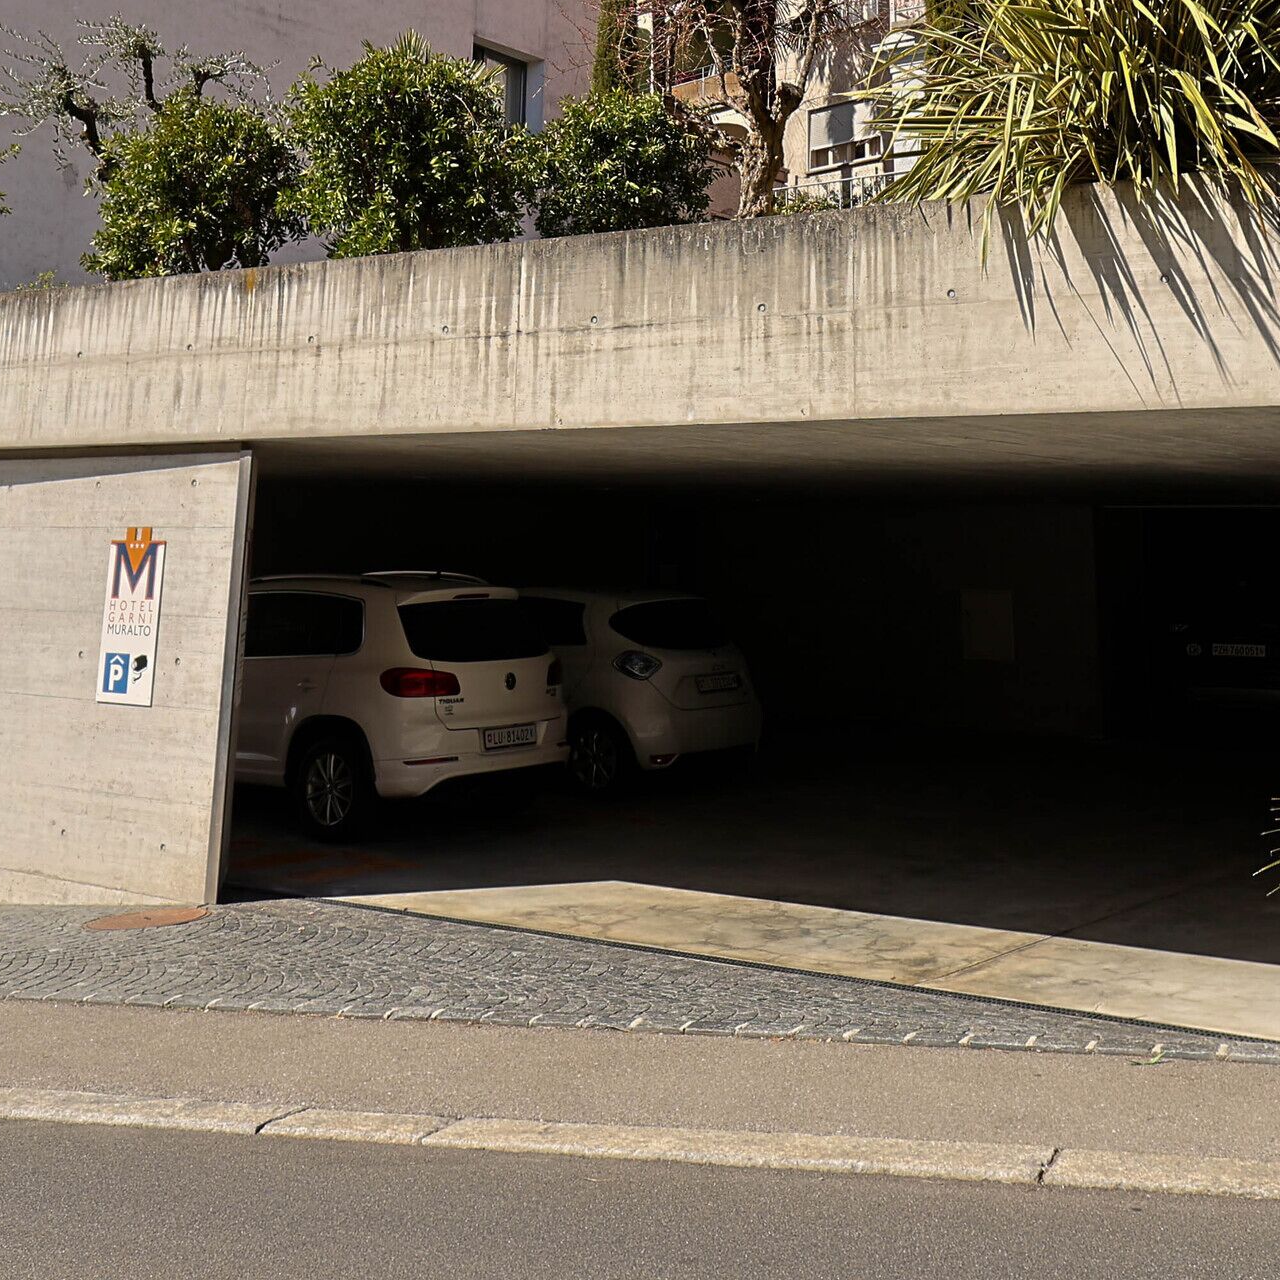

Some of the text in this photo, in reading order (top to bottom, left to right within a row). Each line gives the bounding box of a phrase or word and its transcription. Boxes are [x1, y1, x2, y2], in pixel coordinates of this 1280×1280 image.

[111, 540, 162, 600] M
[109, 600, 153, 612] HOTEL
[108, 611, 153, 624] GARNI
[107, 623, 151, 637] MURALTO
[108, 663, 123, 691] P
